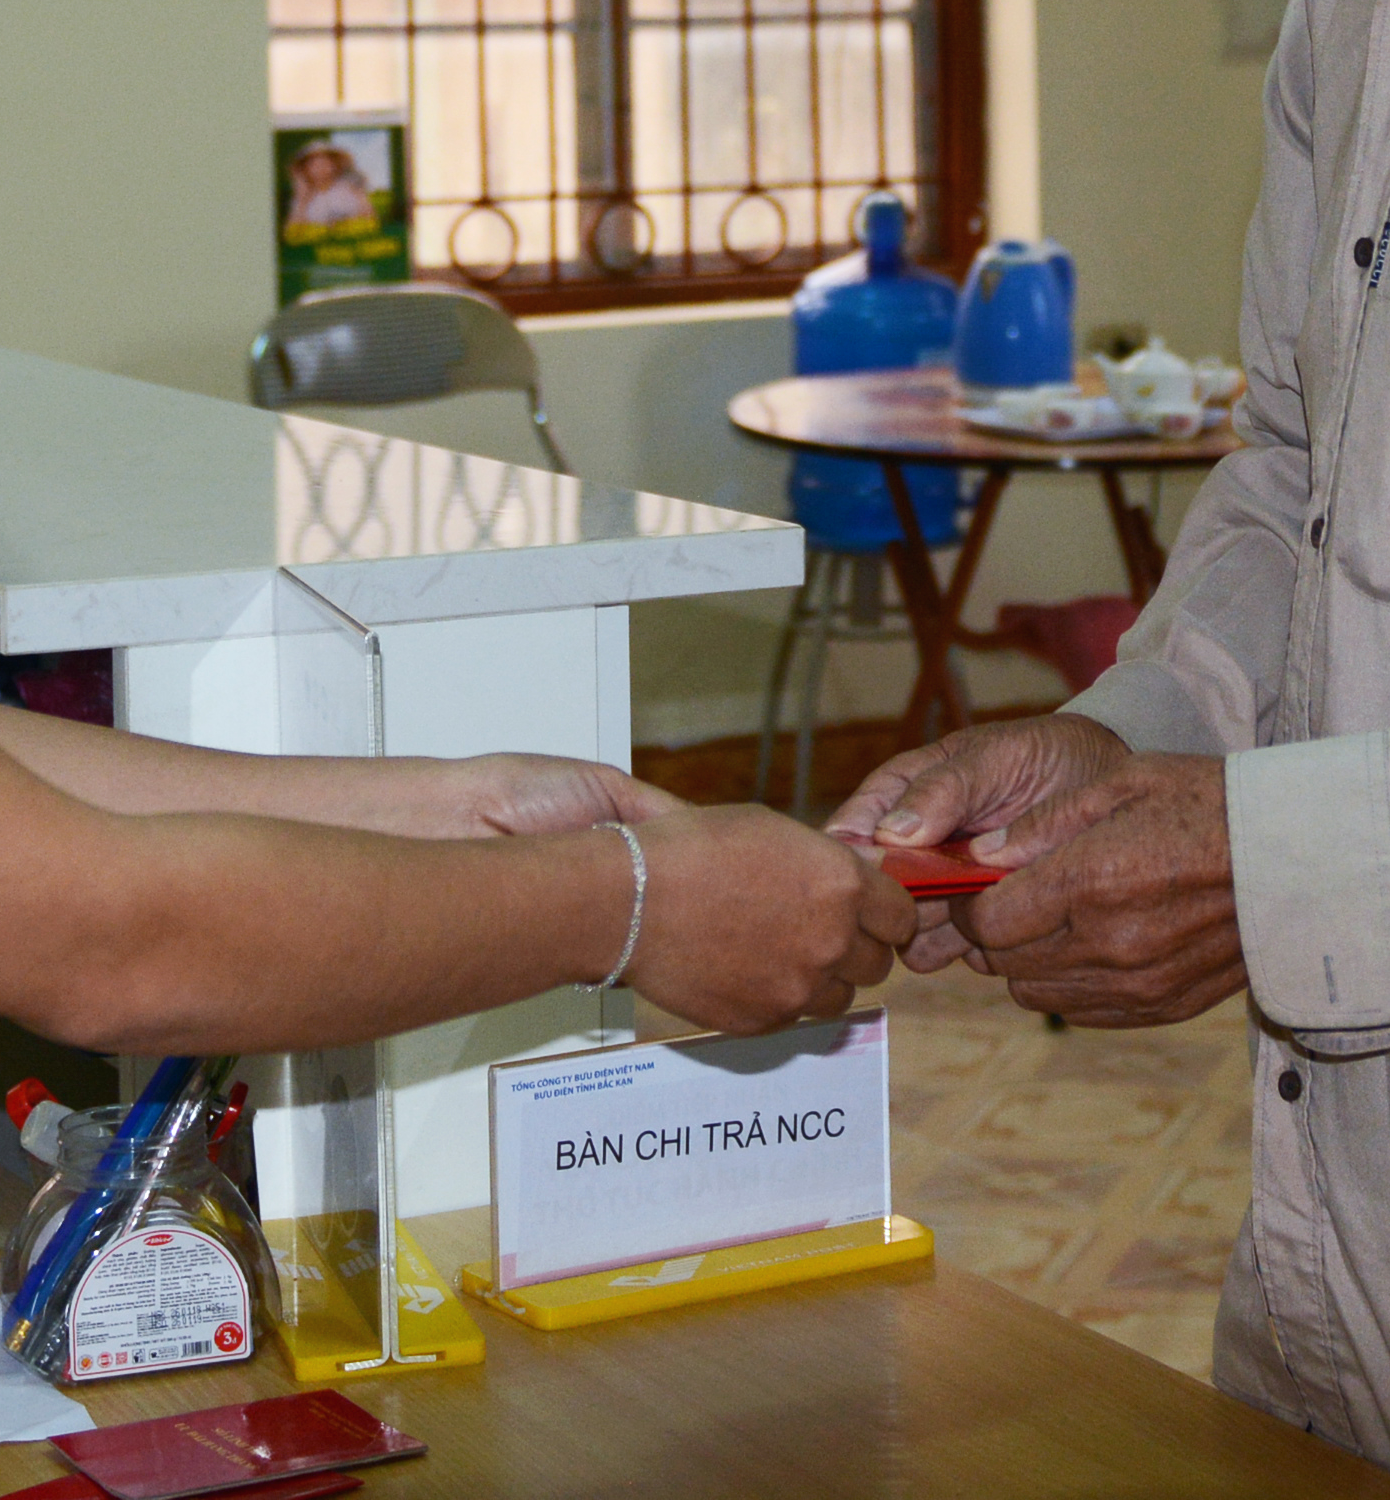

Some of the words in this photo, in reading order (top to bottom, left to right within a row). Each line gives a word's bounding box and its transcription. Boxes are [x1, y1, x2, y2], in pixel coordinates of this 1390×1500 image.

[511, 1080, 535, 1092] TỔNG
[537, 1076, 561, 1088] CÔNG
[562, 1076, 573, 1084] TY
[574, 1071, 593, 1082] BƯU
[594, 1067, 615, 1080] ĐIỆN
[615, 1063, 633, 1076] VIỆT
[634, 1061, 655, 1072] NAM
[534, 1089, 553, 1101] BƯU
[553, 1085, 574, 1098] ĐIỆN
[575, 1082, 596, 1094] TỈNH
[597, 1079, 614, 1091] BẮC
[615, 1077, 633, 1088] KẠN
[556, 1131, 623, 1171] BÀN
[635, 1126, 690, 1161] CHI
[702, 1110, 767, 1153] TRẢ
[777, 1108, 845, 1144] NCC
